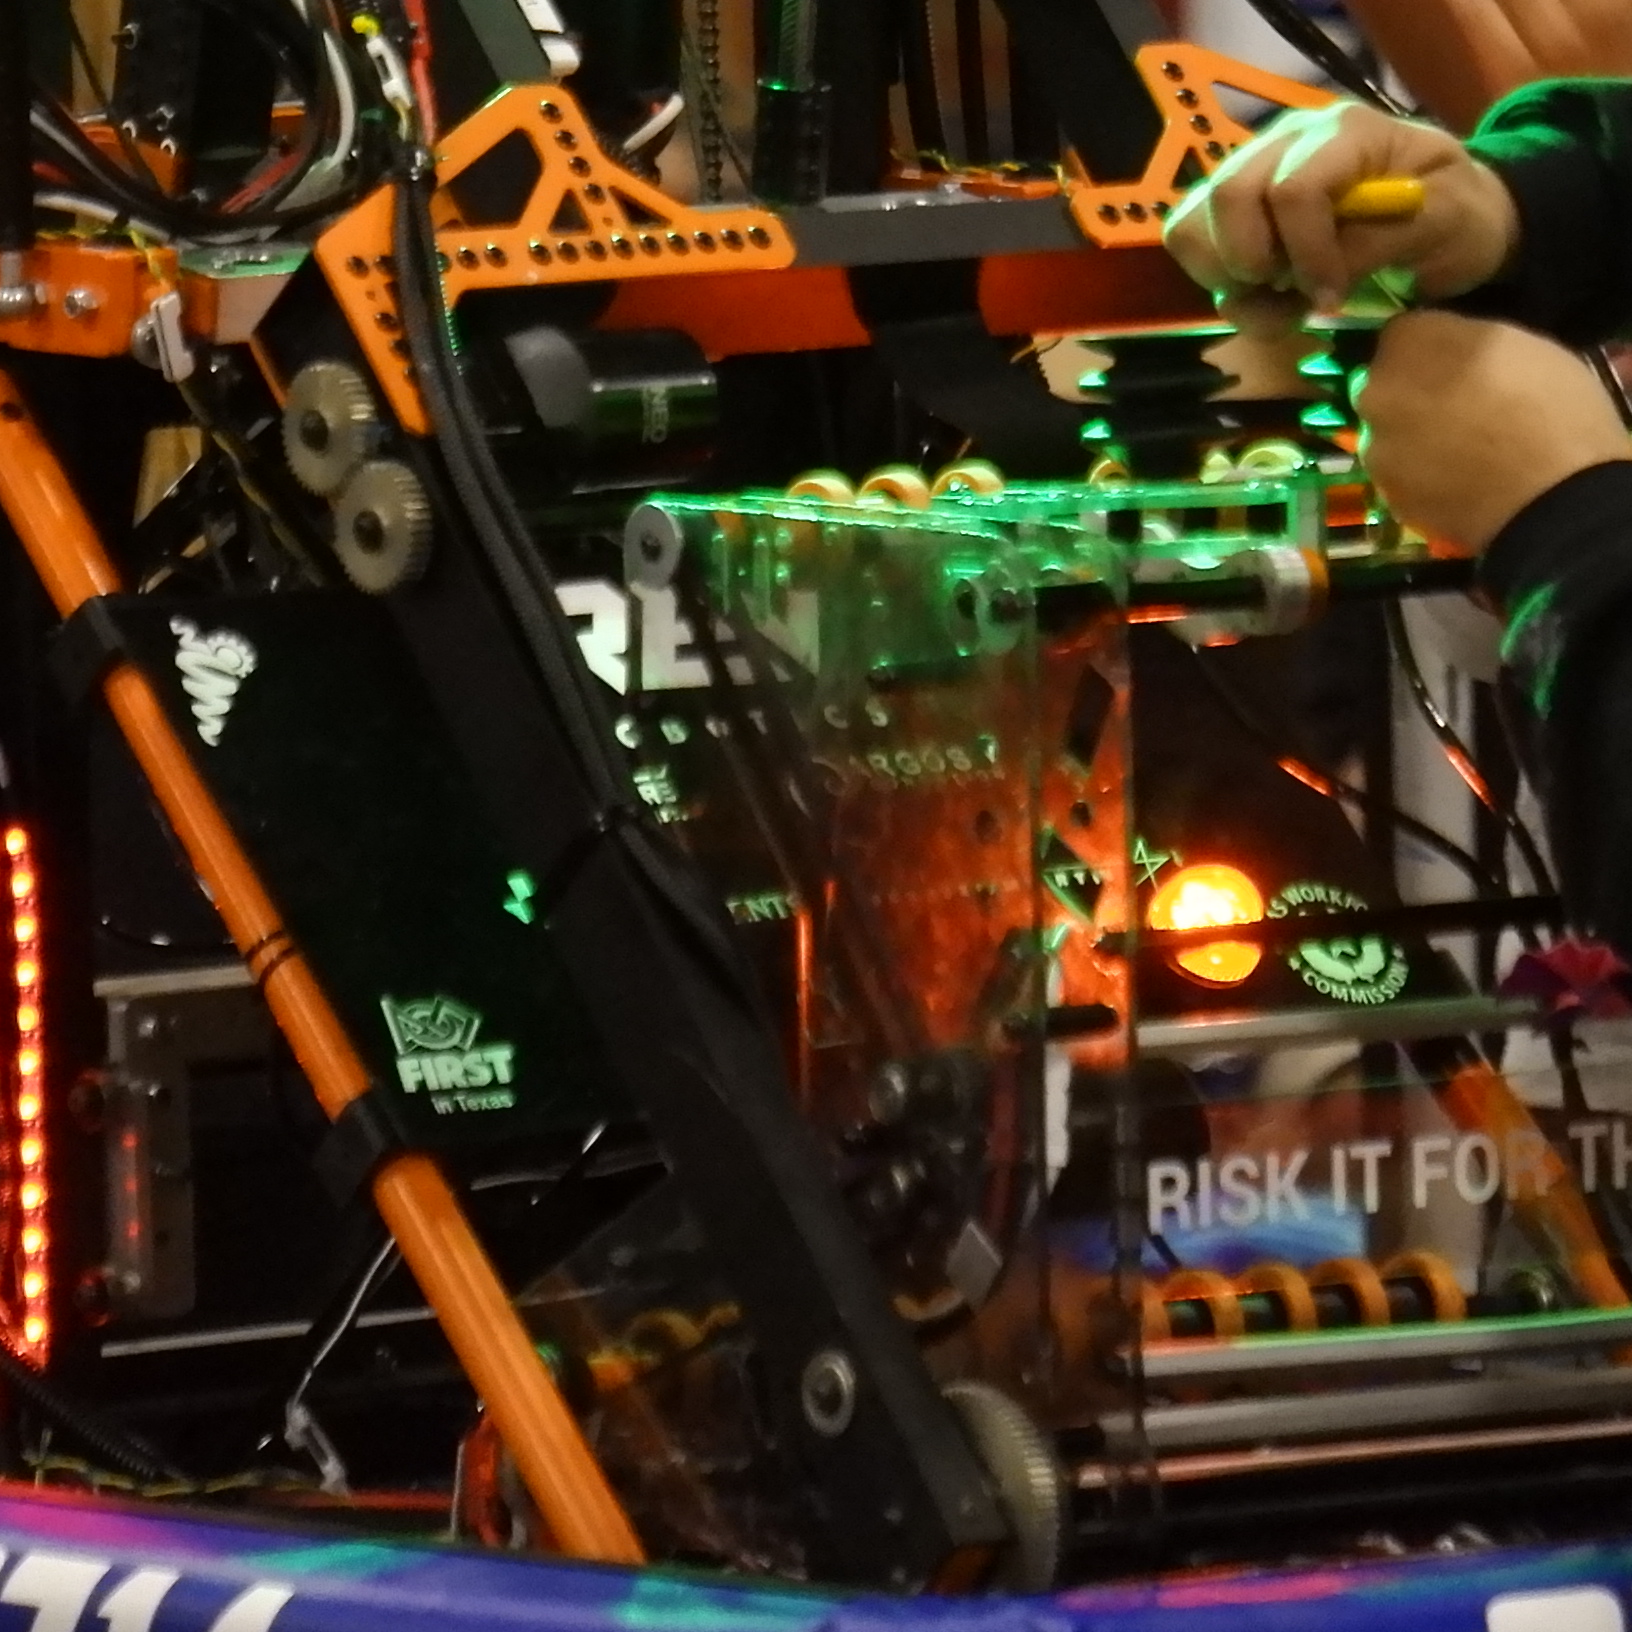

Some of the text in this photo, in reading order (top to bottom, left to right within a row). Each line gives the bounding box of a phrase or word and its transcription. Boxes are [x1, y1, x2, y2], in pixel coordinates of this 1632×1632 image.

[396, 1048, 514, 1094] FIRST
[431, 1092, 516, 1115] in Texas
[1147, 1151, 1312, 1235] RISK
[1331, 1139, 1392, 1215] IT
[1413, 1131, 1556, 1210] FOR
